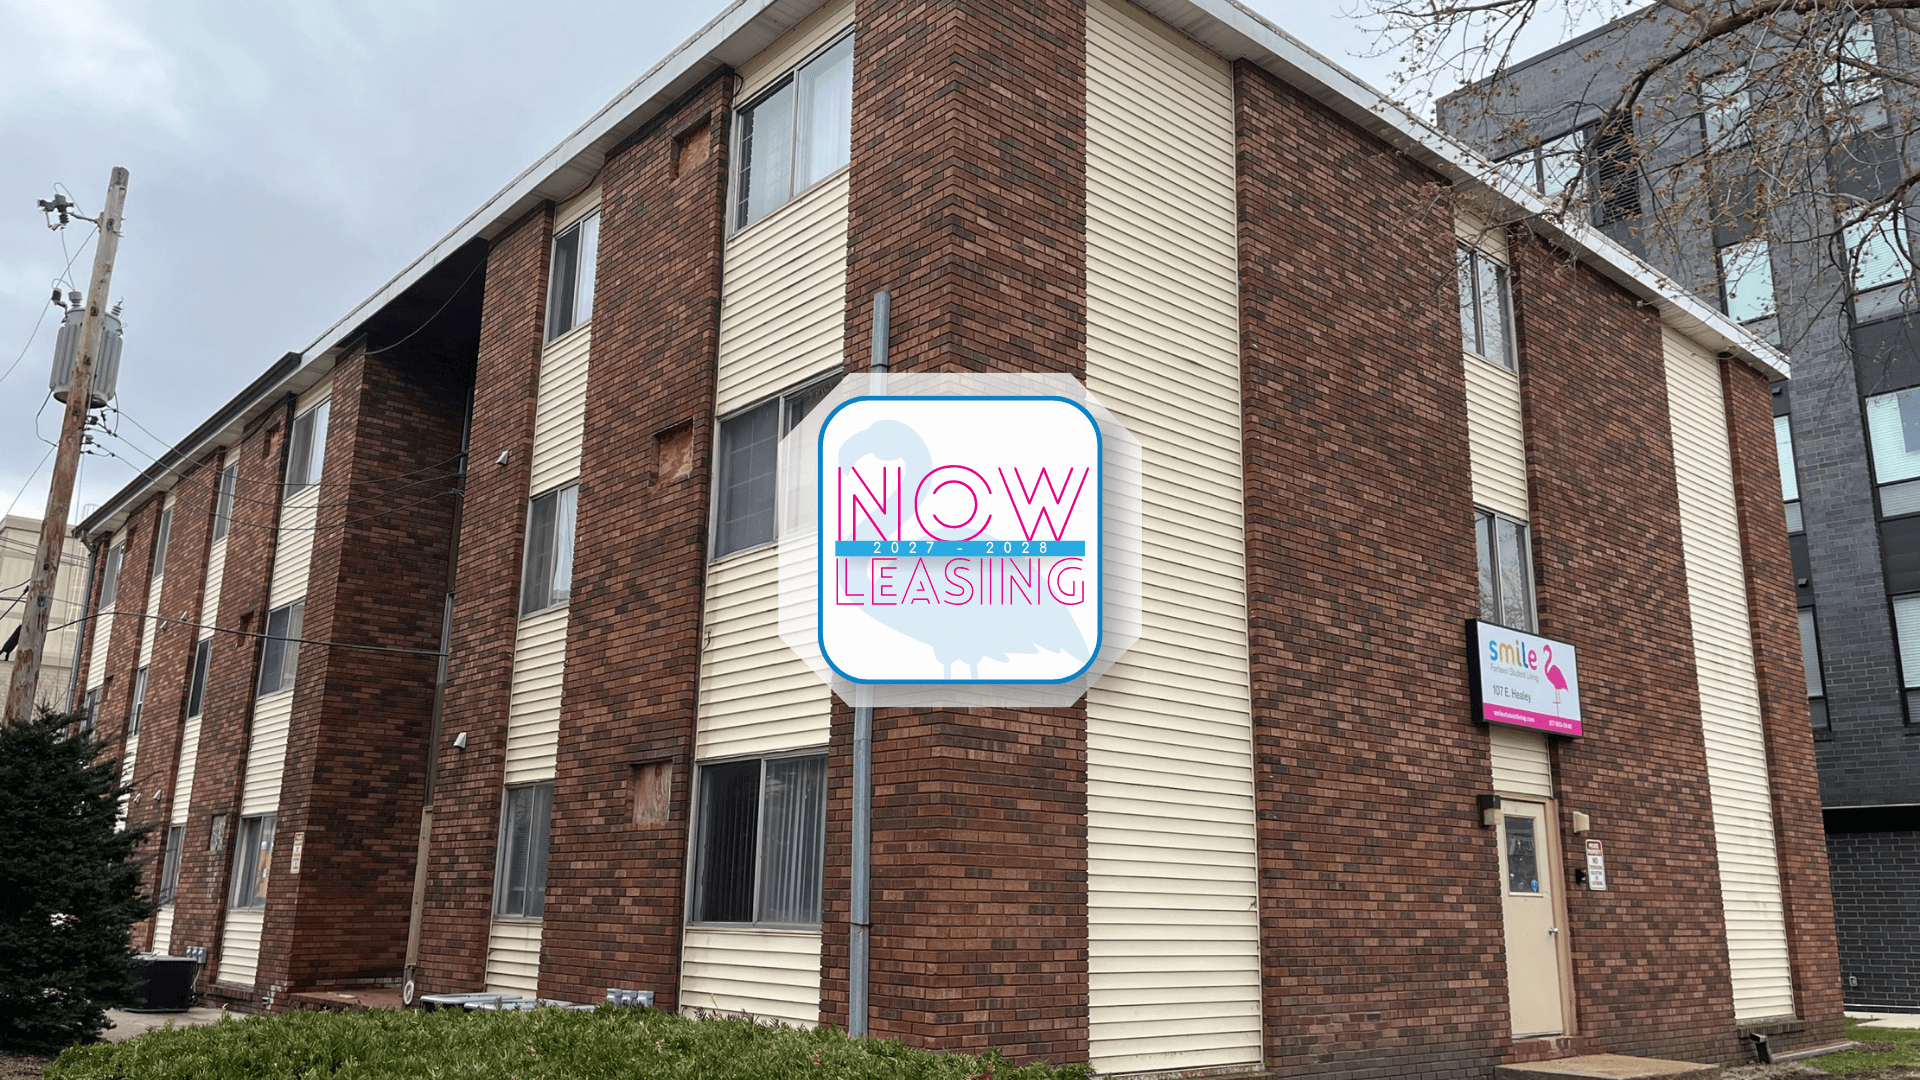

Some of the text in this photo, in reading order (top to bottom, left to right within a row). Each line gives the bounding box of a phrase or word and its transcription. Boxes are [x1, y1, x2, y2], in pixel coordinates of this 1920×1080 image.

[1489, 640, 1537, 670] smile
[1493, 685, 1503, 696] 107
[1511, 688, 1531, 703] Healey
